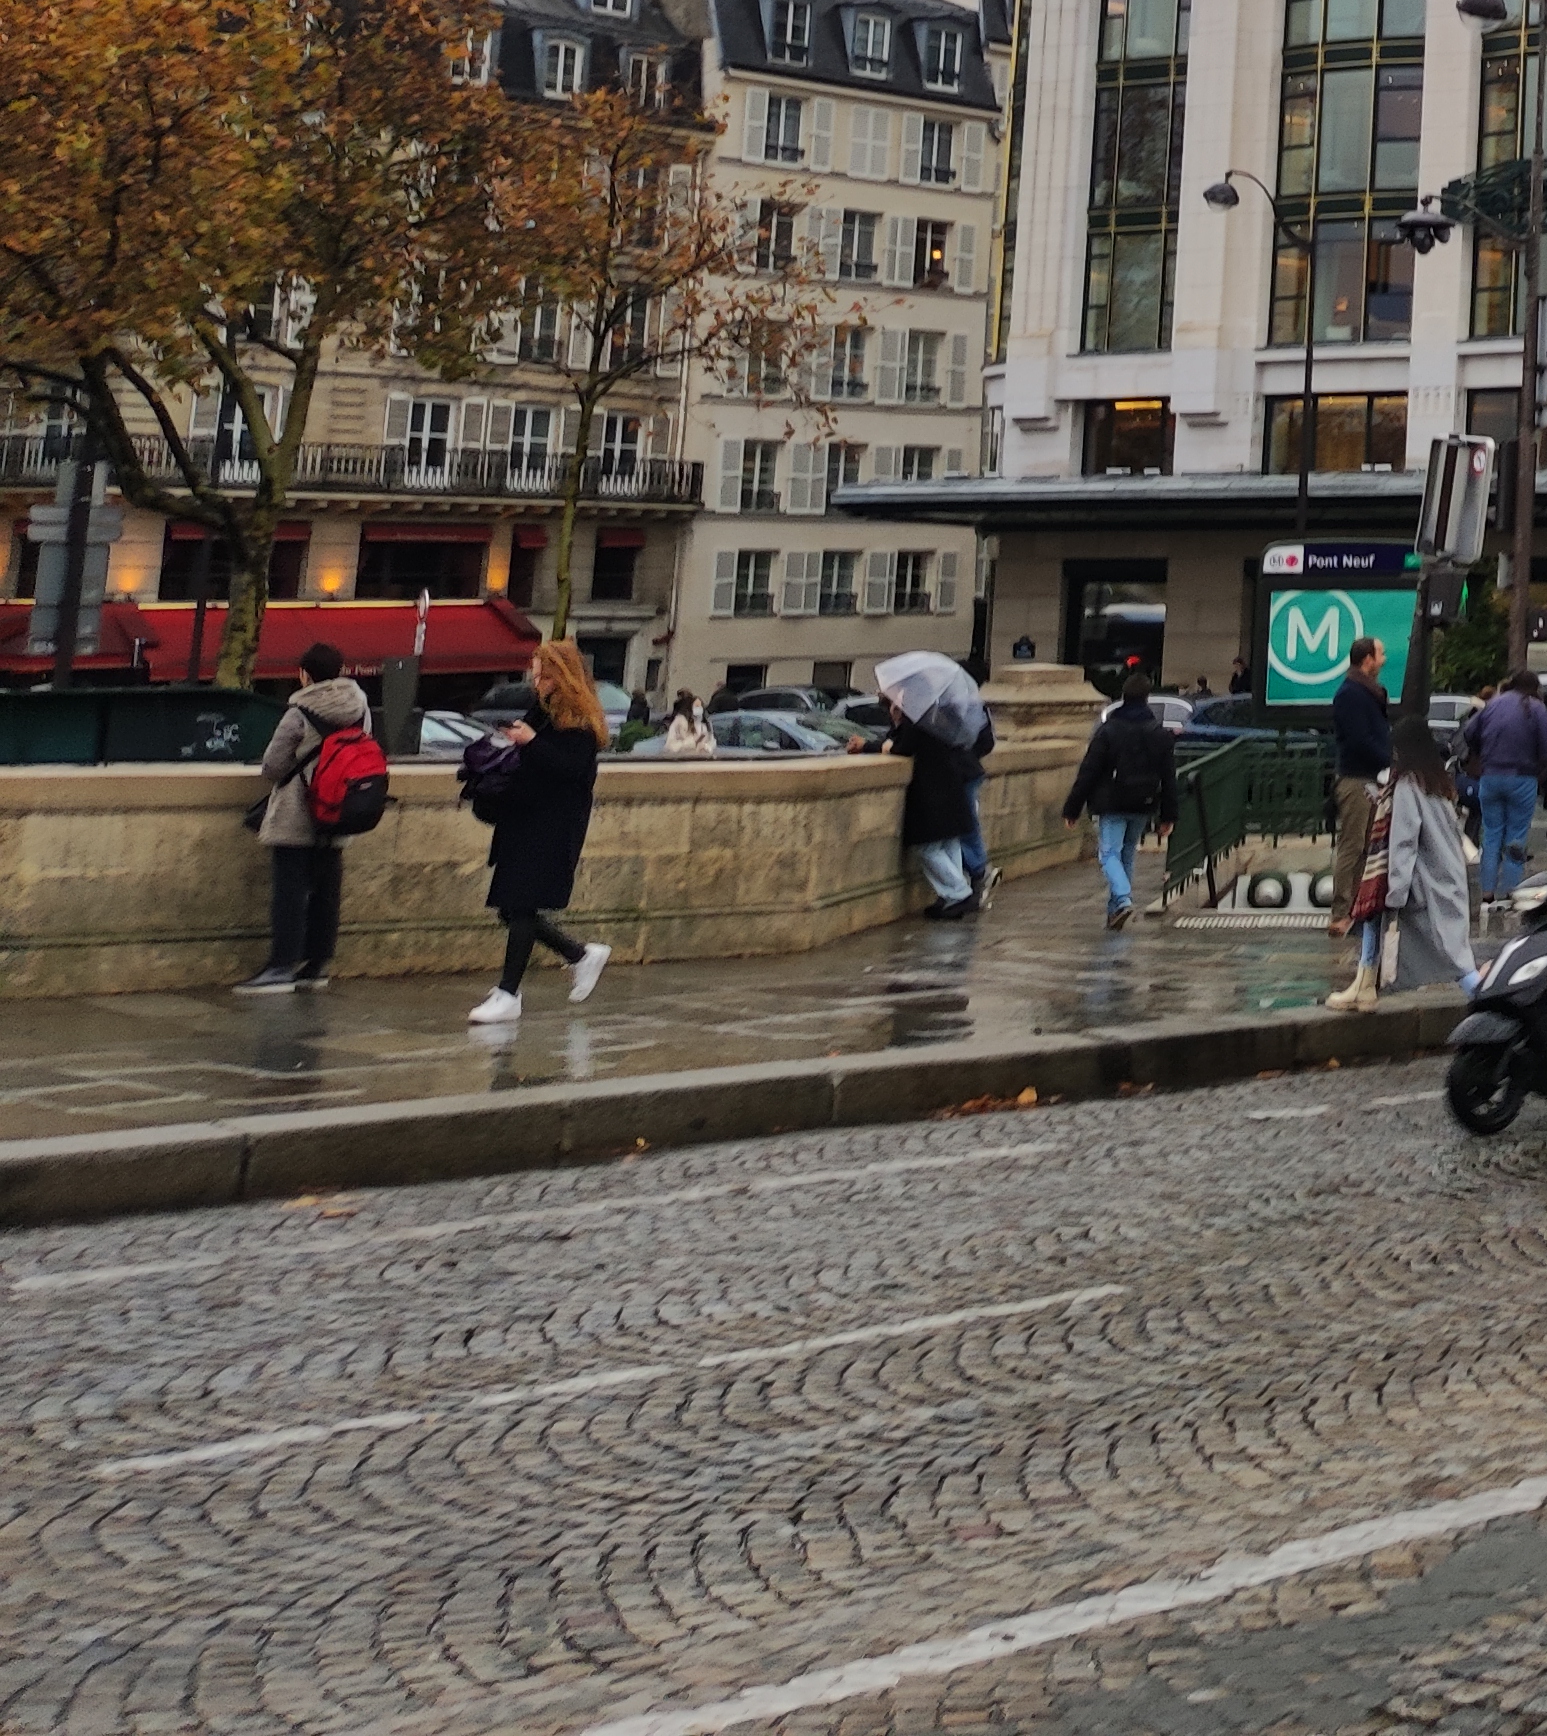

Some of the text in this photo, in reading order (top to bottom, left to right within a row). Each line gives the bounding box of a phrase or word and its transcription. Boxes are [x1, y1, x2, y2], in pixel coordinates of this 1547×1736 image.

[1308, 554, 1339, 569] Pont
[1342, 553, 1376, 569] Neuf
[1286, 605, 1340, 661] M
